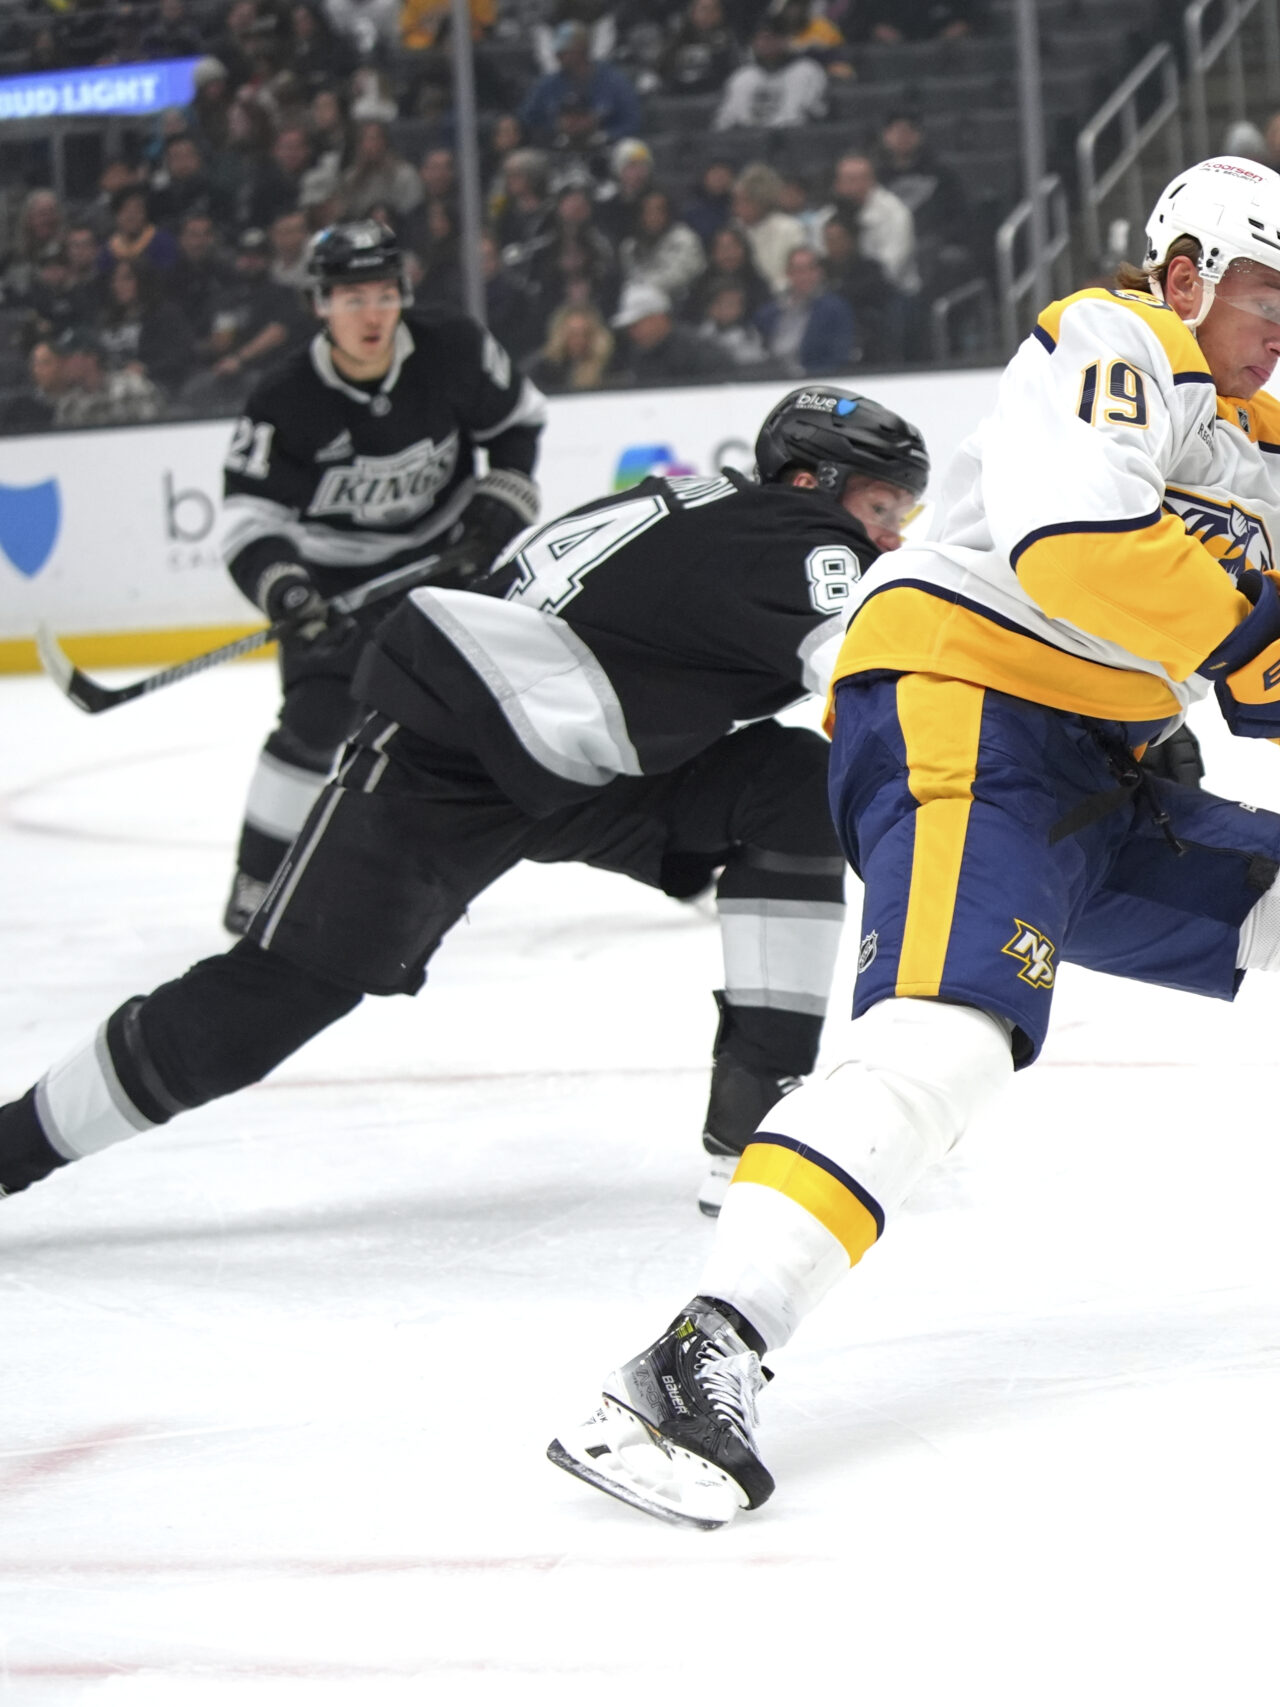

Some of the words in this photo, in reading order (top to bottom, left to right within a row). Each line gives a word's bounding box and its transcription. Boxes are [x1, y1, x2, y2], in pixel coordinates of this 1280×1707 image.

[62, 73, 159, 112] LIGHT
[797, 392, 838, 408] blue
[1075, 357, 1149, 430] 19
[225, 416, 276, 480] 21
[492, 494, 671, 617] 4
[1008, 926, 1054, 985] NP
